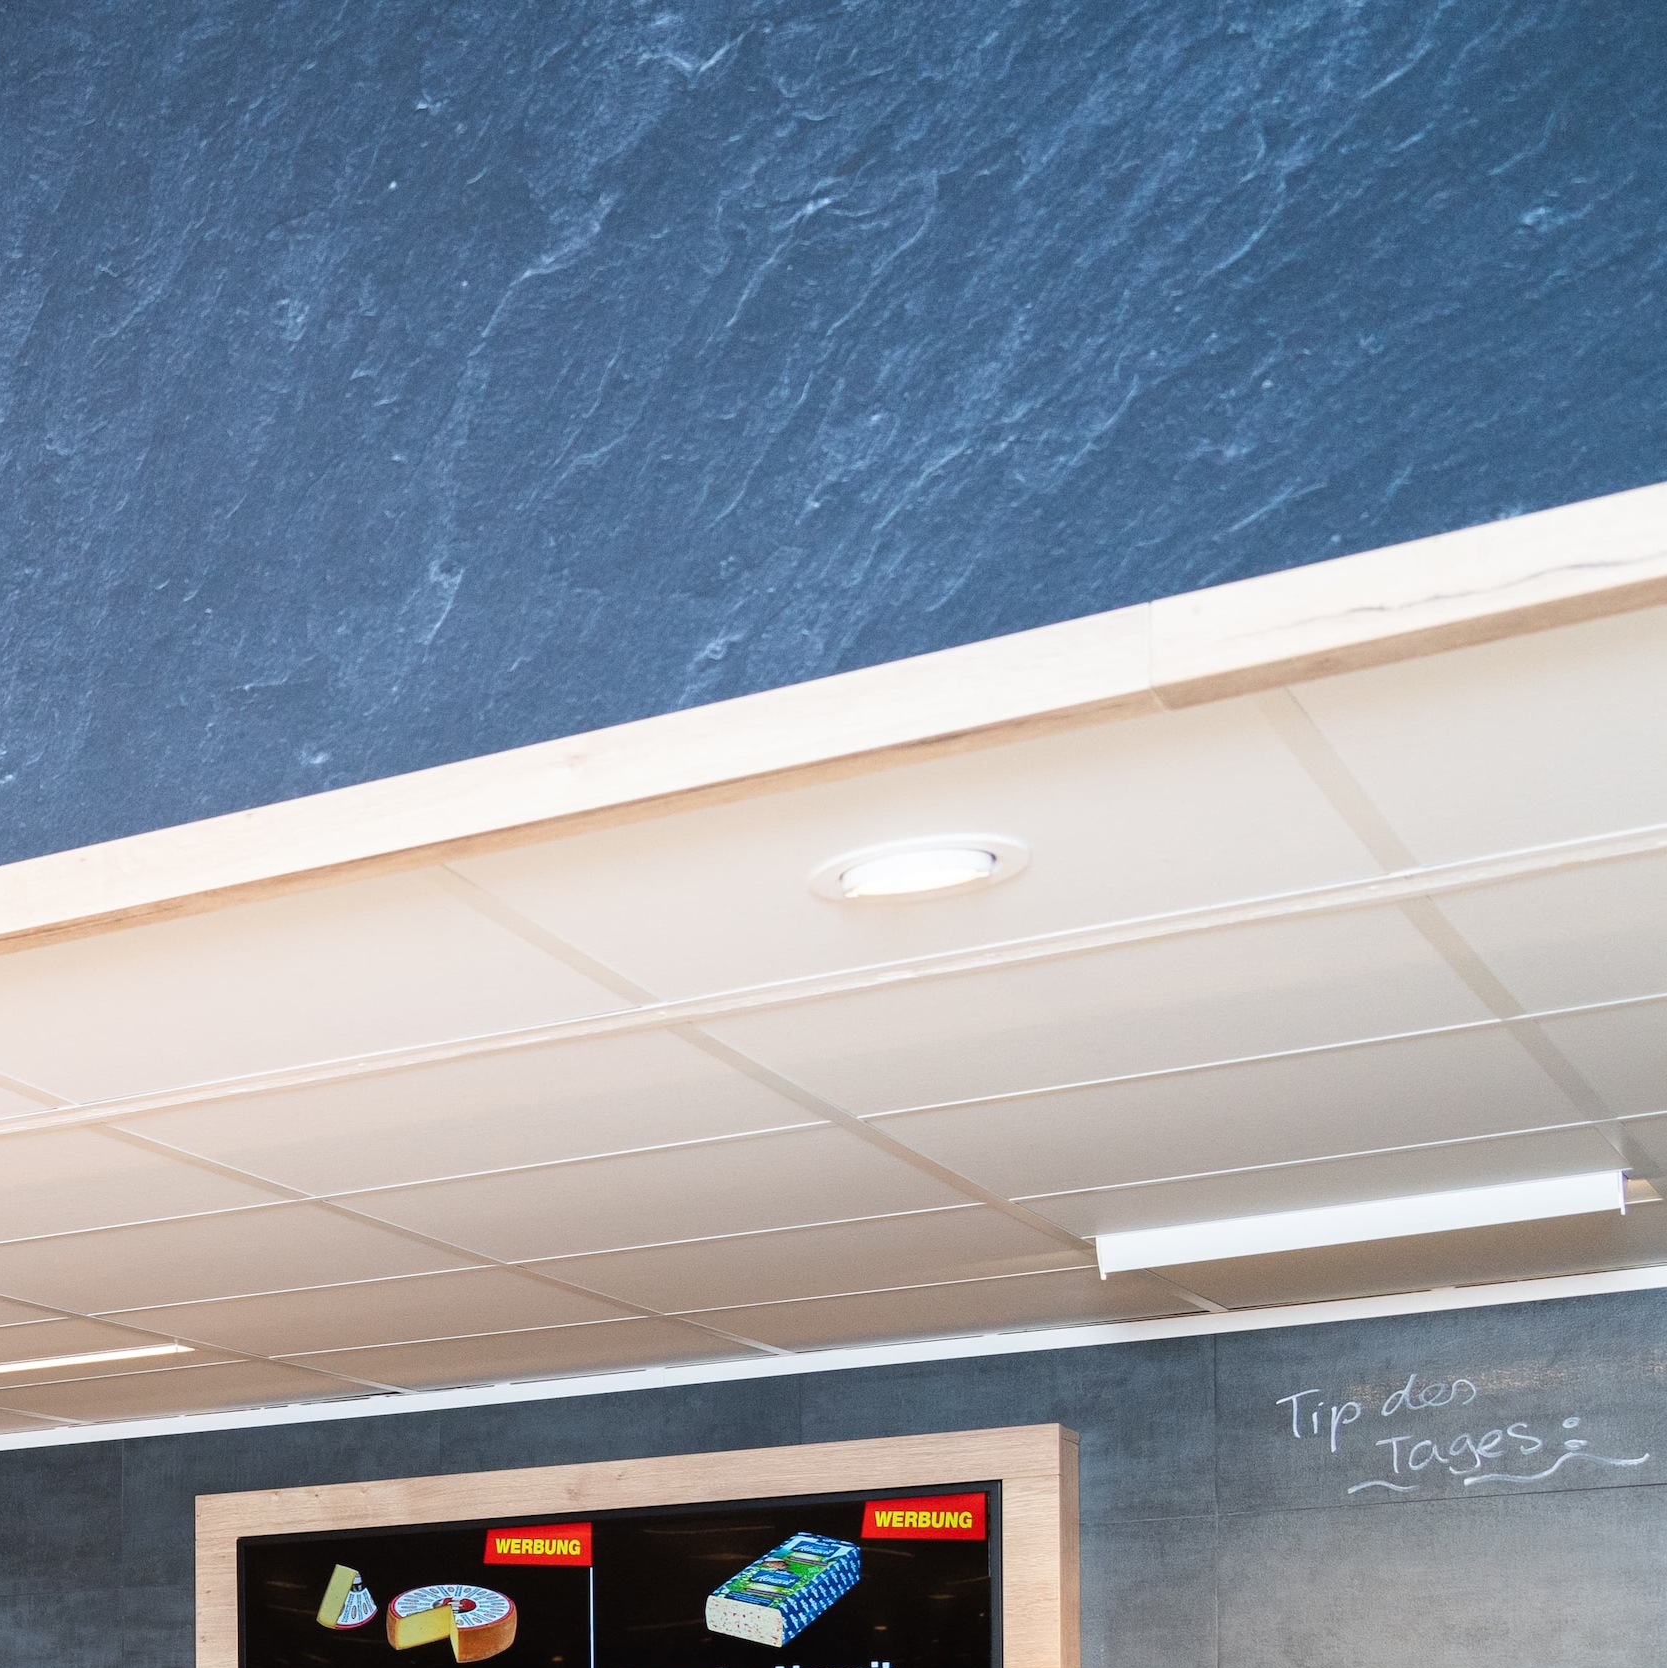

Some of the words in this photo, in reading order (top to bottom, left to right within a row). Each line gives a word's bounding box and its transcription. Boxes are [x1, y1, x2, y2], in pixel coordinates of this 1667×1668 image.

[1276, 1389, 1362, 1452] Tip
[874, 1508, 974, 1532] WERBUNG
[495, 1535, 581, 1560] WERBUNG
